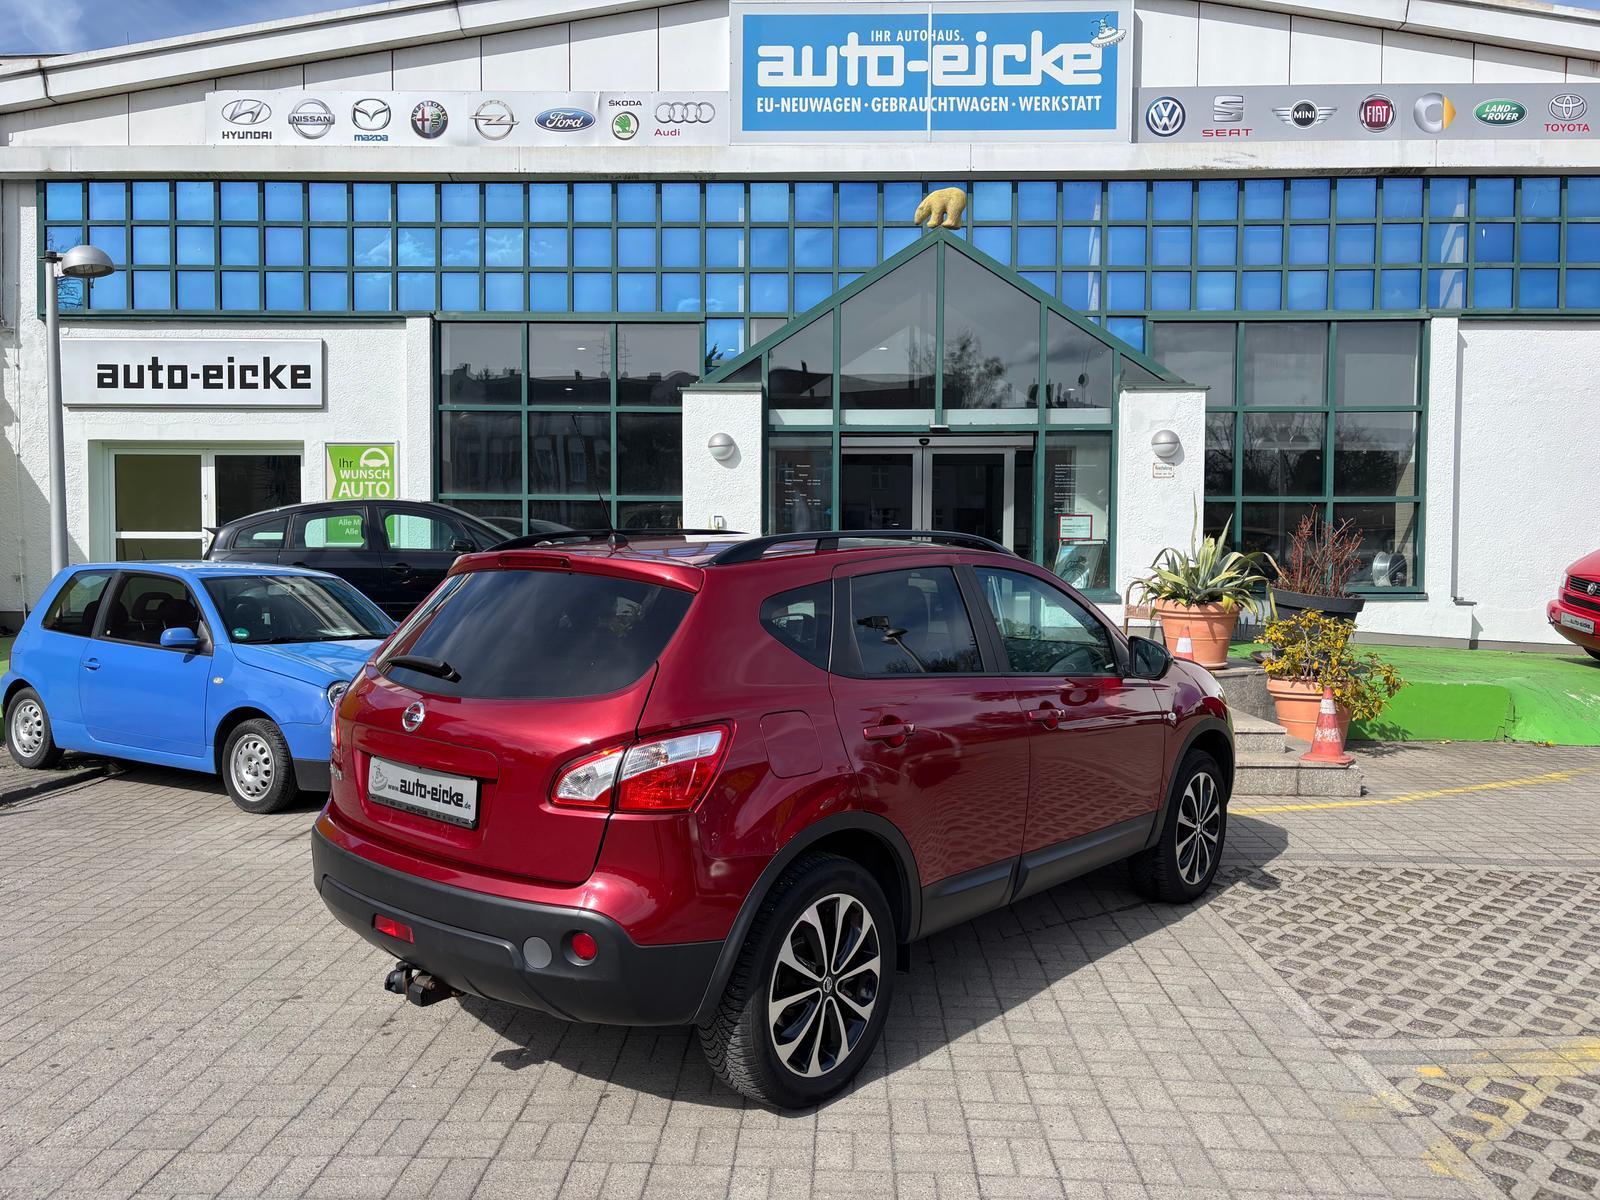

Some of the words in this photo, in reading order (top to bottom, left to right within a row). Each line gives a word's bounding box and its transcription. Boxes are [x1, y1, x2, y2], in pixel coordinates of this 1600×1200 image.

[870, 30, 891, 42] IHR
[896, 29, 965, 42] AUTOHAUS.
[757, 30, 1102, 87] auto-eicke
[756, 96, 862, 113] EU-NEUWAGEN
[871, 96, 1009, 112] GEBRAUCHTWAGEN
[1018, 95, 1102, 111] WERKSTATT
[291, 115, 332, 123] NISSAN
[545, 111, 584, 128] Ford
[1293, 110, 1316, 119] MINI
[1366, 105, 1389, 123] FIAT
[653, 128, 681, 137] Audi
[1201, 128, 1253, 138] SEAT
[1543, 123, 1591, 132] TOYOTA
[221, 130, 273, 140] HYUNDAI
[96, 356, 312, 390] auto-eicke
[338, 457, 354, 468] Ihr
[339, 469, 390, 480] WUNSCH
[338, 481, 391, 498] AUTO
[338, 518, 352, 527] Alle
[344, 528, 359, 536] Alle
